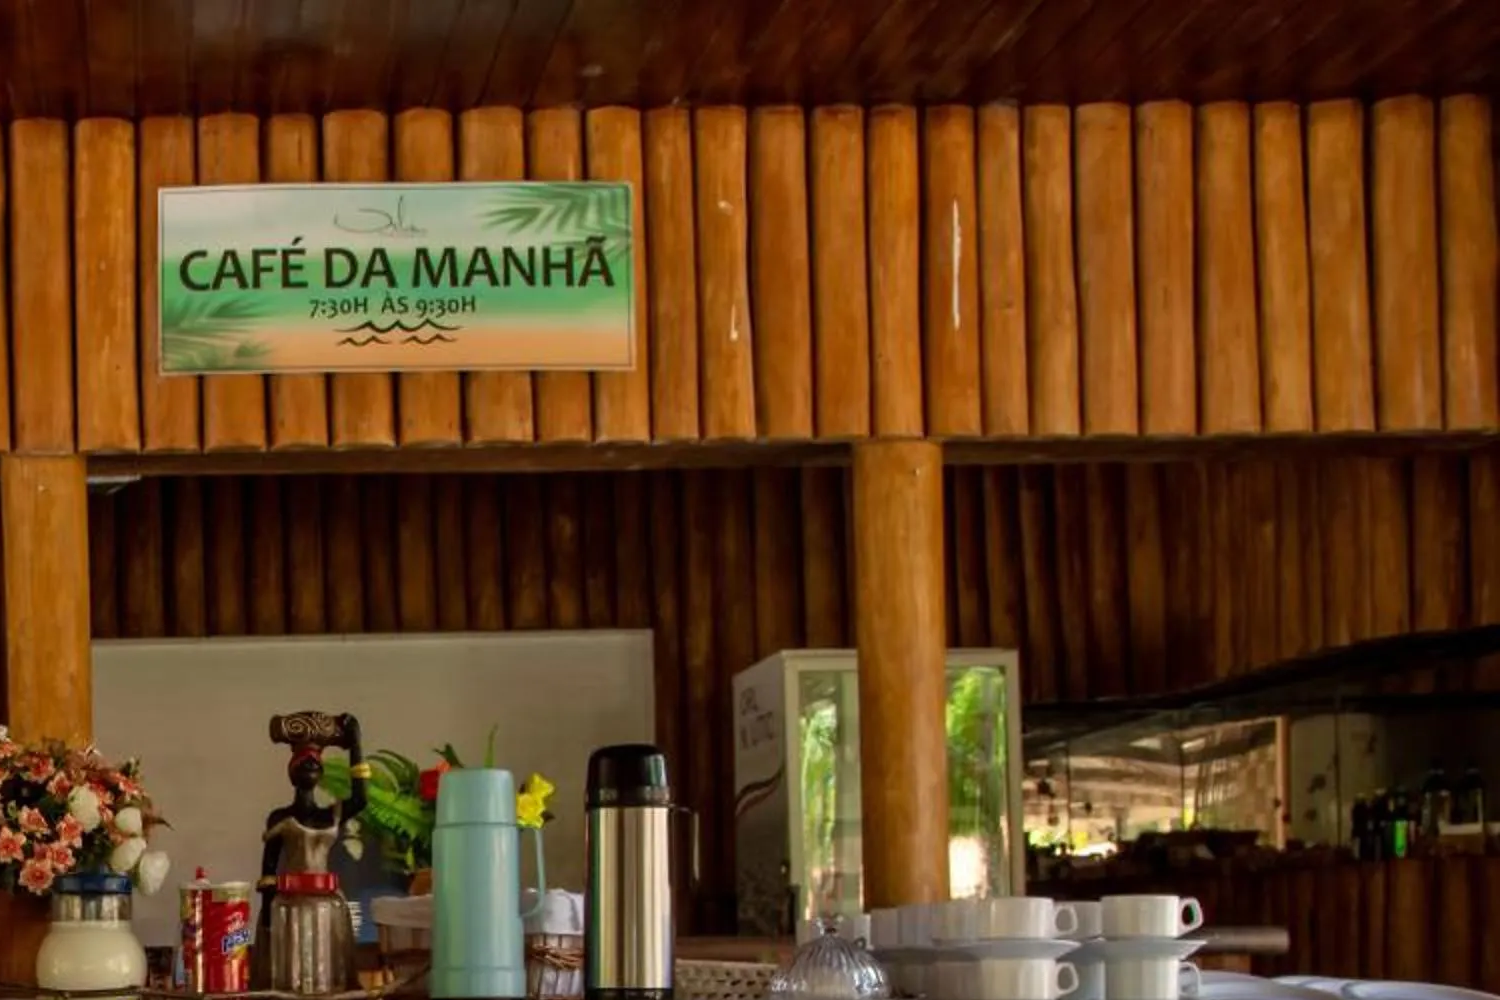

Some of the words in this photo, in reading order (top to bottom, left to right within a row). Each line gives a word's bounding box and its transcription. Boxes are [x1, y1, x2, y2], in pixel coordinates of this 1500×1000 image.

[179, 236, 309, 292] CAFÉ
[323, 247, 398, 289] DA
[411, 235, 615, 288] MANHÃ
[308, 295, 369, 319] 7:30H
[415, 295, 477, 319] 9:30H
